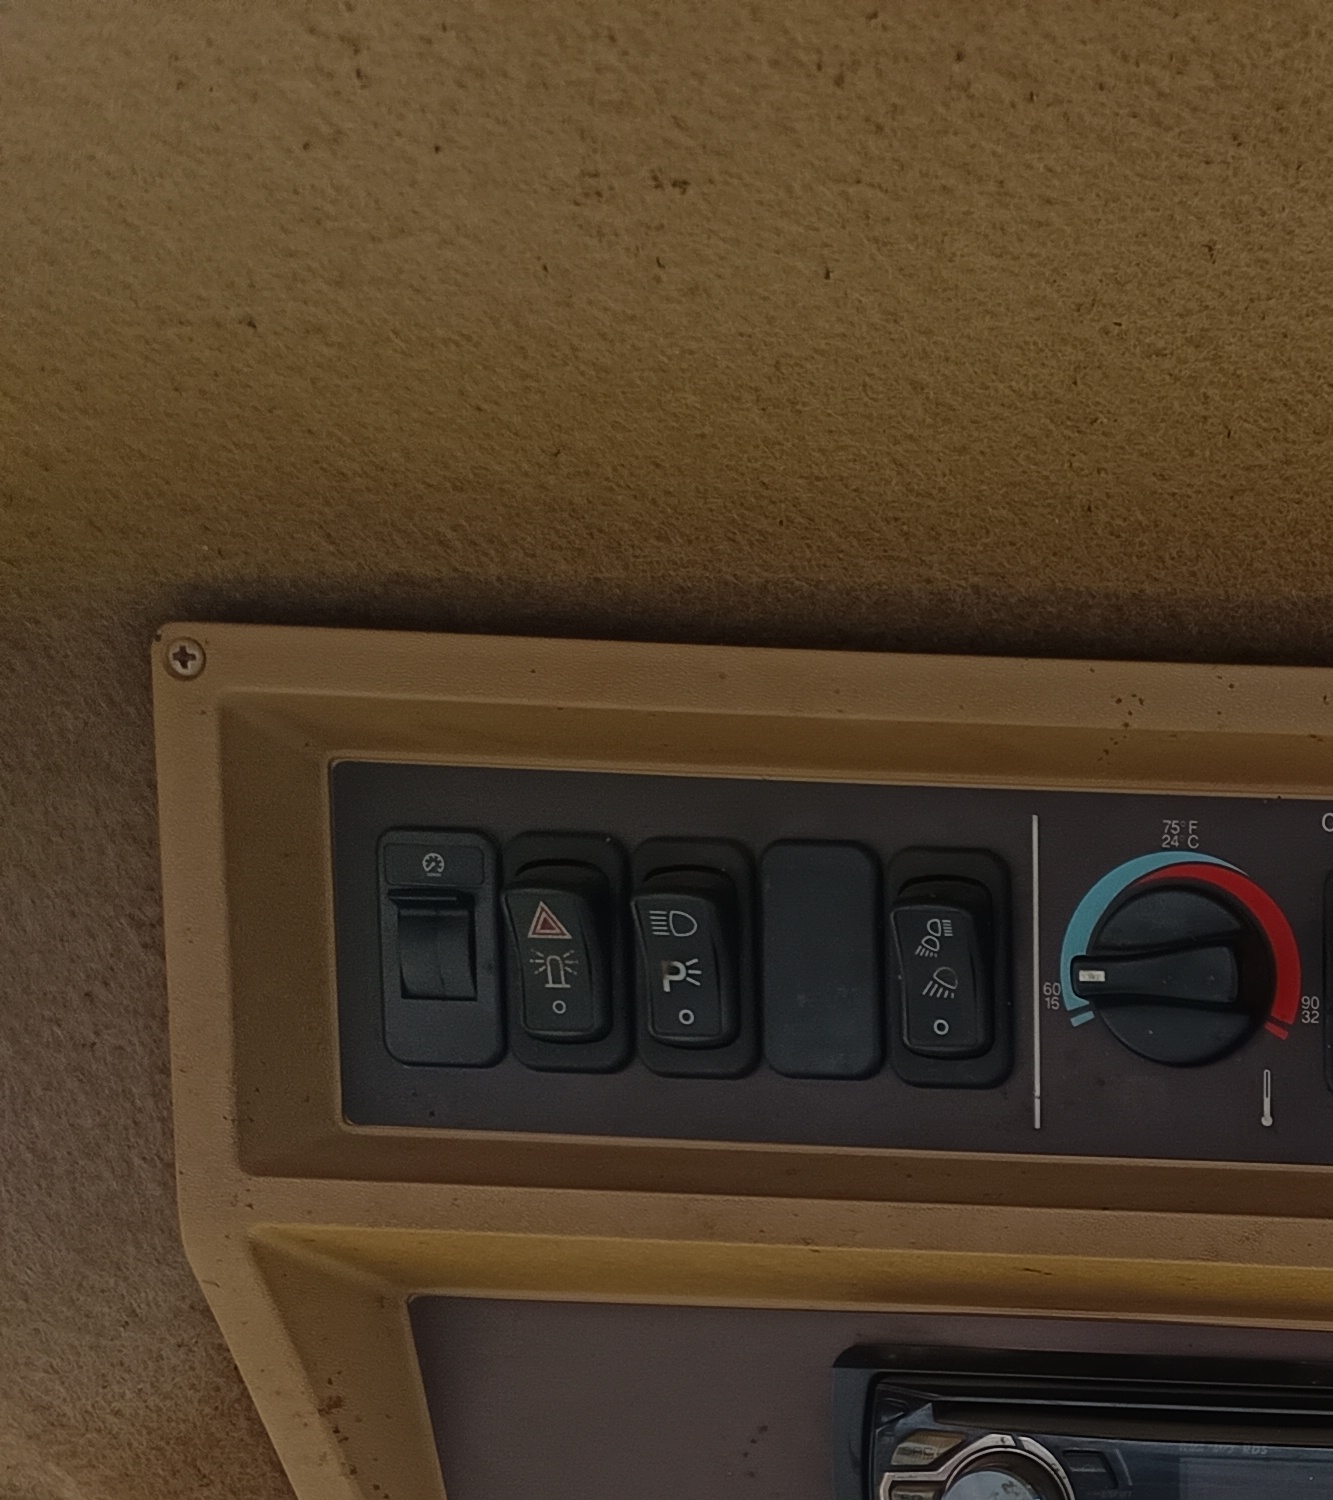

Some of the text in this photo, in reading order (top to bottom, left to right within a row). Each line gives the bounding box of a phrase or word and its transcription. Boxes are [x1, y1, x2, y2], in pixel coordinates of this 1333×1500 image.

[1042, 982, 1061, 996] 60
[1045, 996, 1060, 1010] 15
[1301, 996, 1320, 1010] 90
[1301, 1010, 1320, 1024] 32
